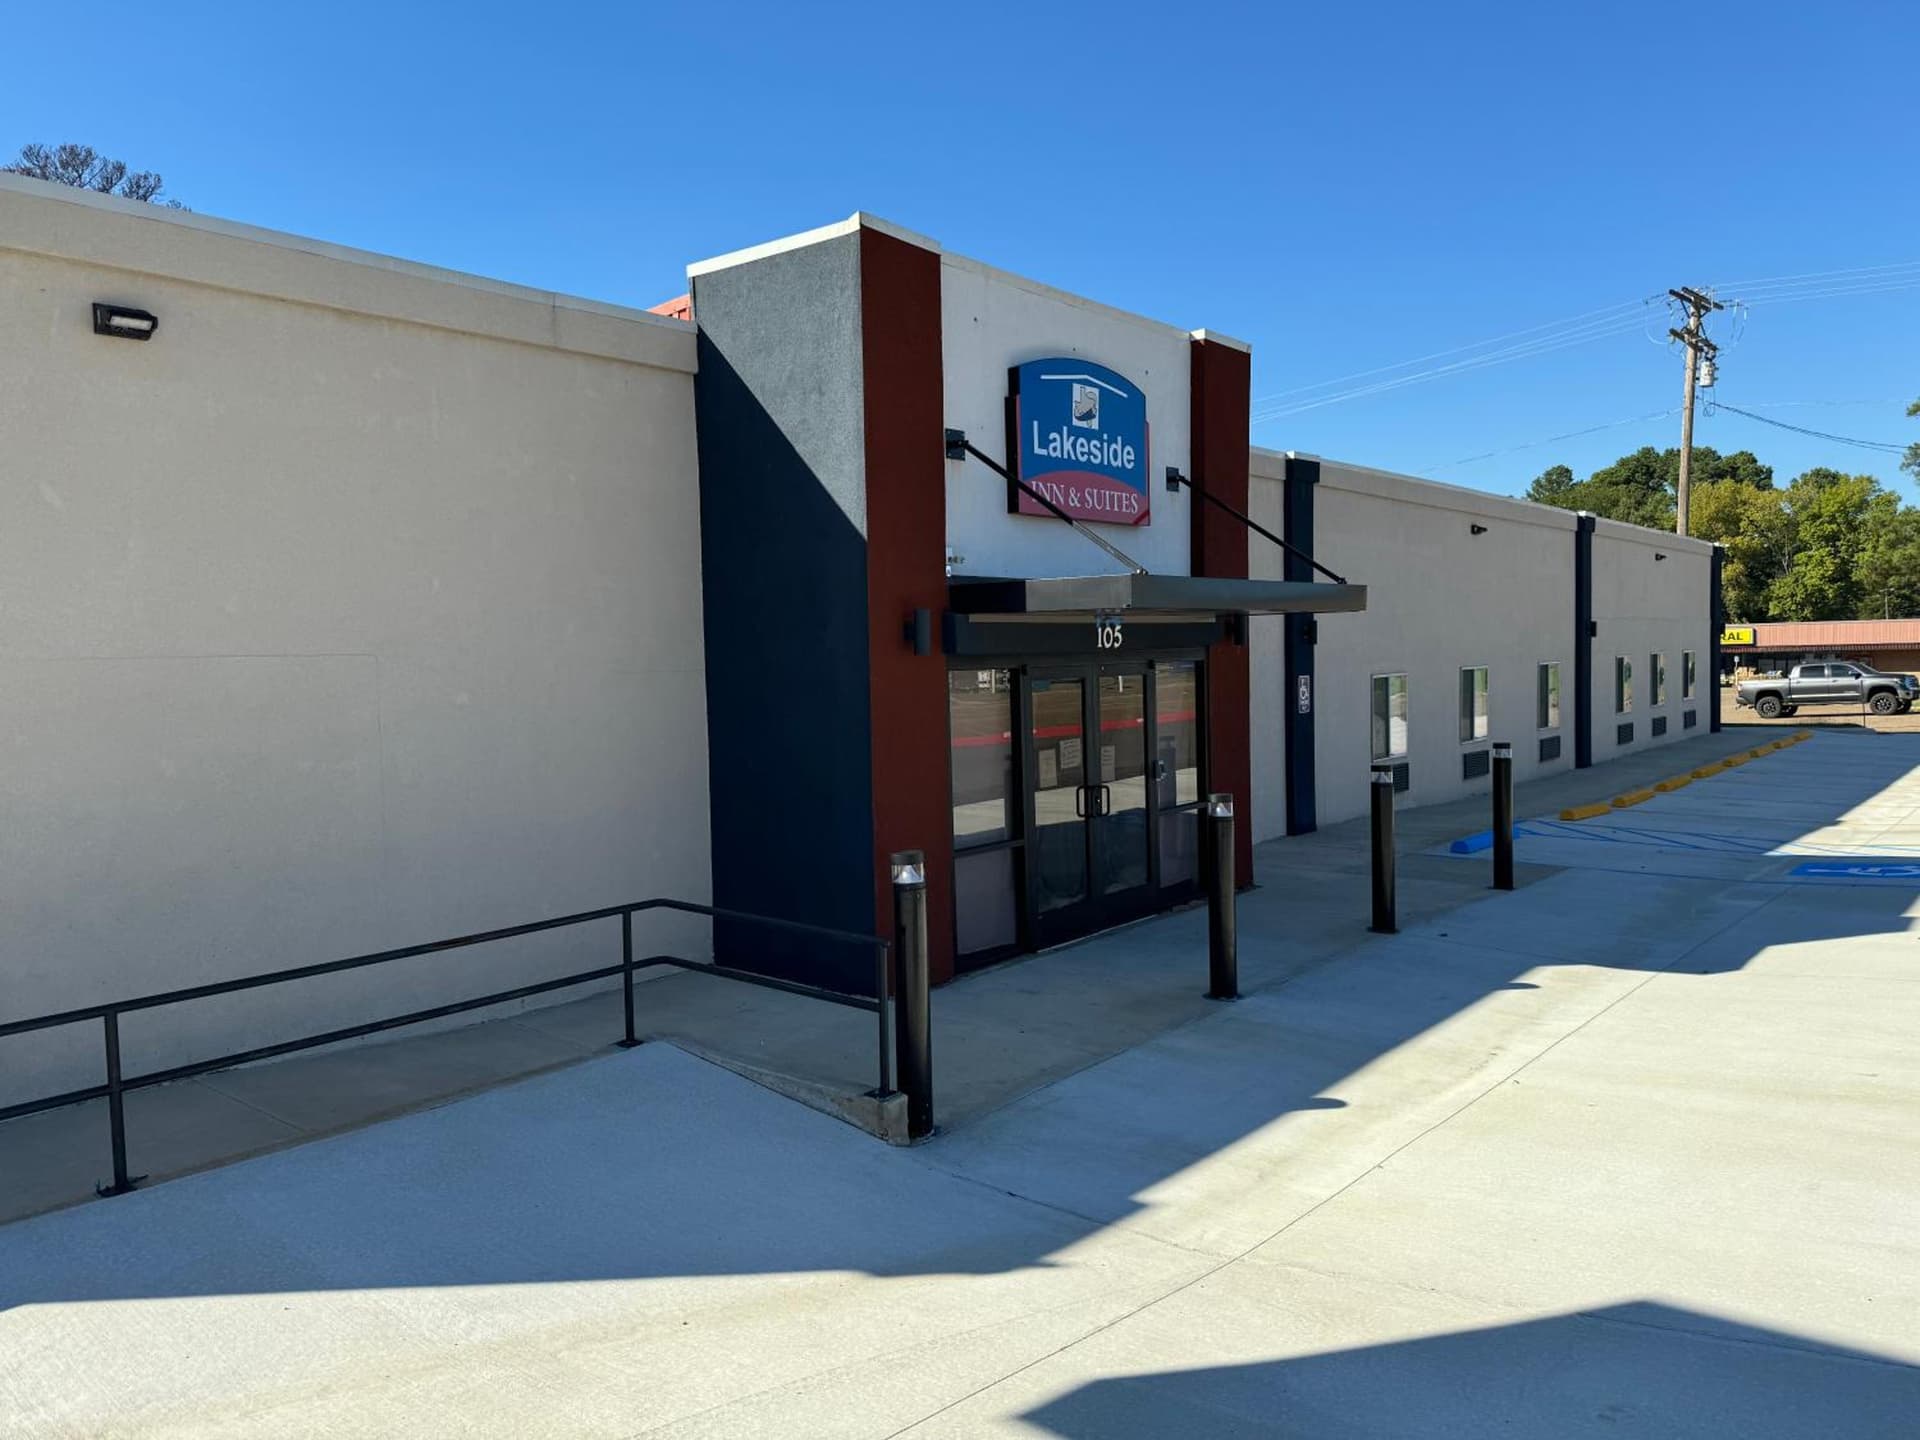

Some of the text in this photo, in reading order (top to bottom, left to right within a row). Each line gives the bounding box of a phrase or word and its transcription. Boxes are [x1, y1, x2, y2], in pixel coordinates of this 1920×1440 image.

[1033, 420, 1135, 469] Lakeside
[1032, 481, 1139, 514] INN & SUITES
[1097, 625, 1122, 648] 105
